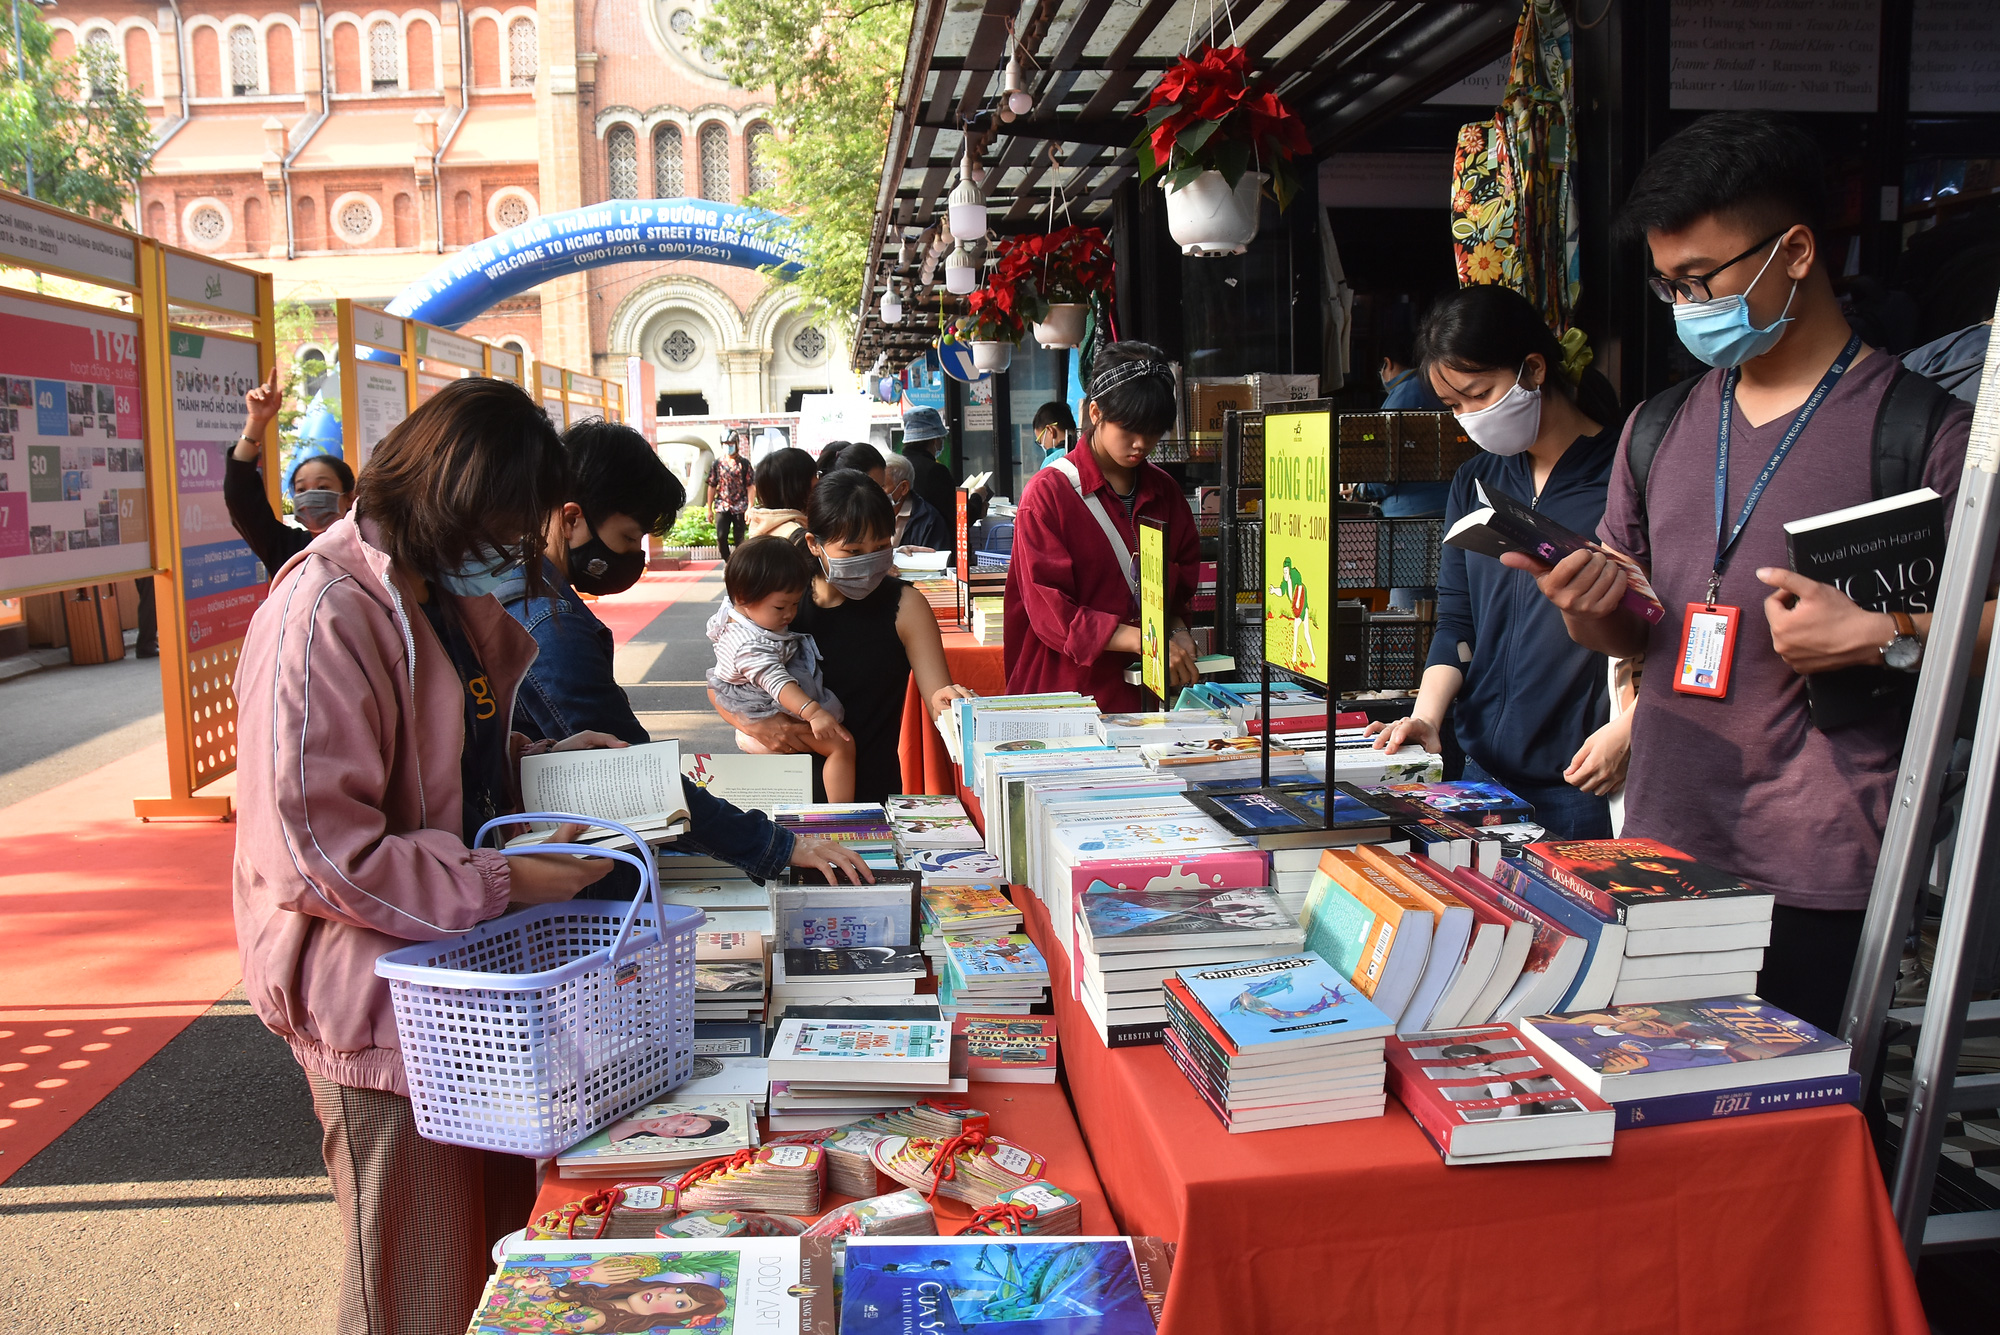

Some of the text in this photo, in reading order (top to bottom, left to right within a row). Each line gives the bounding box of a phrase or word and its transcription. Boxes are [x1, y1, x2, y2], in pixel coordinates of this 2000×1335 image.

[14, 217, 33, 233] MINH
[484, 244, 546, 281] WELCOME
[545, 240, 564, 256] TO
[566, 231, 604, 252] HCMC
[606, 227, 641, 244] BOOK
[646, 226, 692, 240] STREET
[573, 243, 732, 267] (09/01/2016 09/01/2021)
[90, 326, 138, 366] 1194
[38, 391, 53, 409] 40
[117, 395, 130, 414] 36
[177, 398, 200, 413] THÀNH
[201, 396, 215, 413] PHỐ
[215, 396, 225, 414] HỒ
[226, 399, 238, 414] CHÍ
[180, 448, 208, 477] 300
[1743, 384, 1829, 515] FACULTY OF LAW HUTECH UNIVERSITY
[31, 455, 47, 475] 30
[1269, 448, 1327, 504] ĐỒNG GIÁ
[120, 499, 134, 518] 67
[184, 504, 201, 533] 40
[1269, 513, 1327, 542] 10K 50K 100K
[1810, 548, 1847, 565] Yuval
[1850, 538, 1887, 557] Noah
[1889, 526, 1932, 545] Harari
[1685, 626, 1697, 663] HUTECH
[1569, 876, 1596, 906] POLLOCK
[803, 919, 817, 946] bab
[814, 925, 828, 941] có
[825, 917, 839, 946] muô
[838, 916, 857, 948] khôn
[852, 924, 867, 944] Em
[1202, 959, 1304, 980] ANIMORPHS
[1117, 1030, 1163, 1042] KERSTIN GI
[1455, 1091, 1576, 1109] Anna Funder
[1760, 1093, 1790, 1105] AMIS
[1795, 1088, 1844, 1100] MARTIN
[801, 1257, 812, 1333] TÔ MÀU SÁNG TẠO
[917, 1281, 943, 1318] CỬA
[1139, 1261, 1162, 1323] TÔ MÀU SÁN
[756, 1299, 780, 1329] ART
